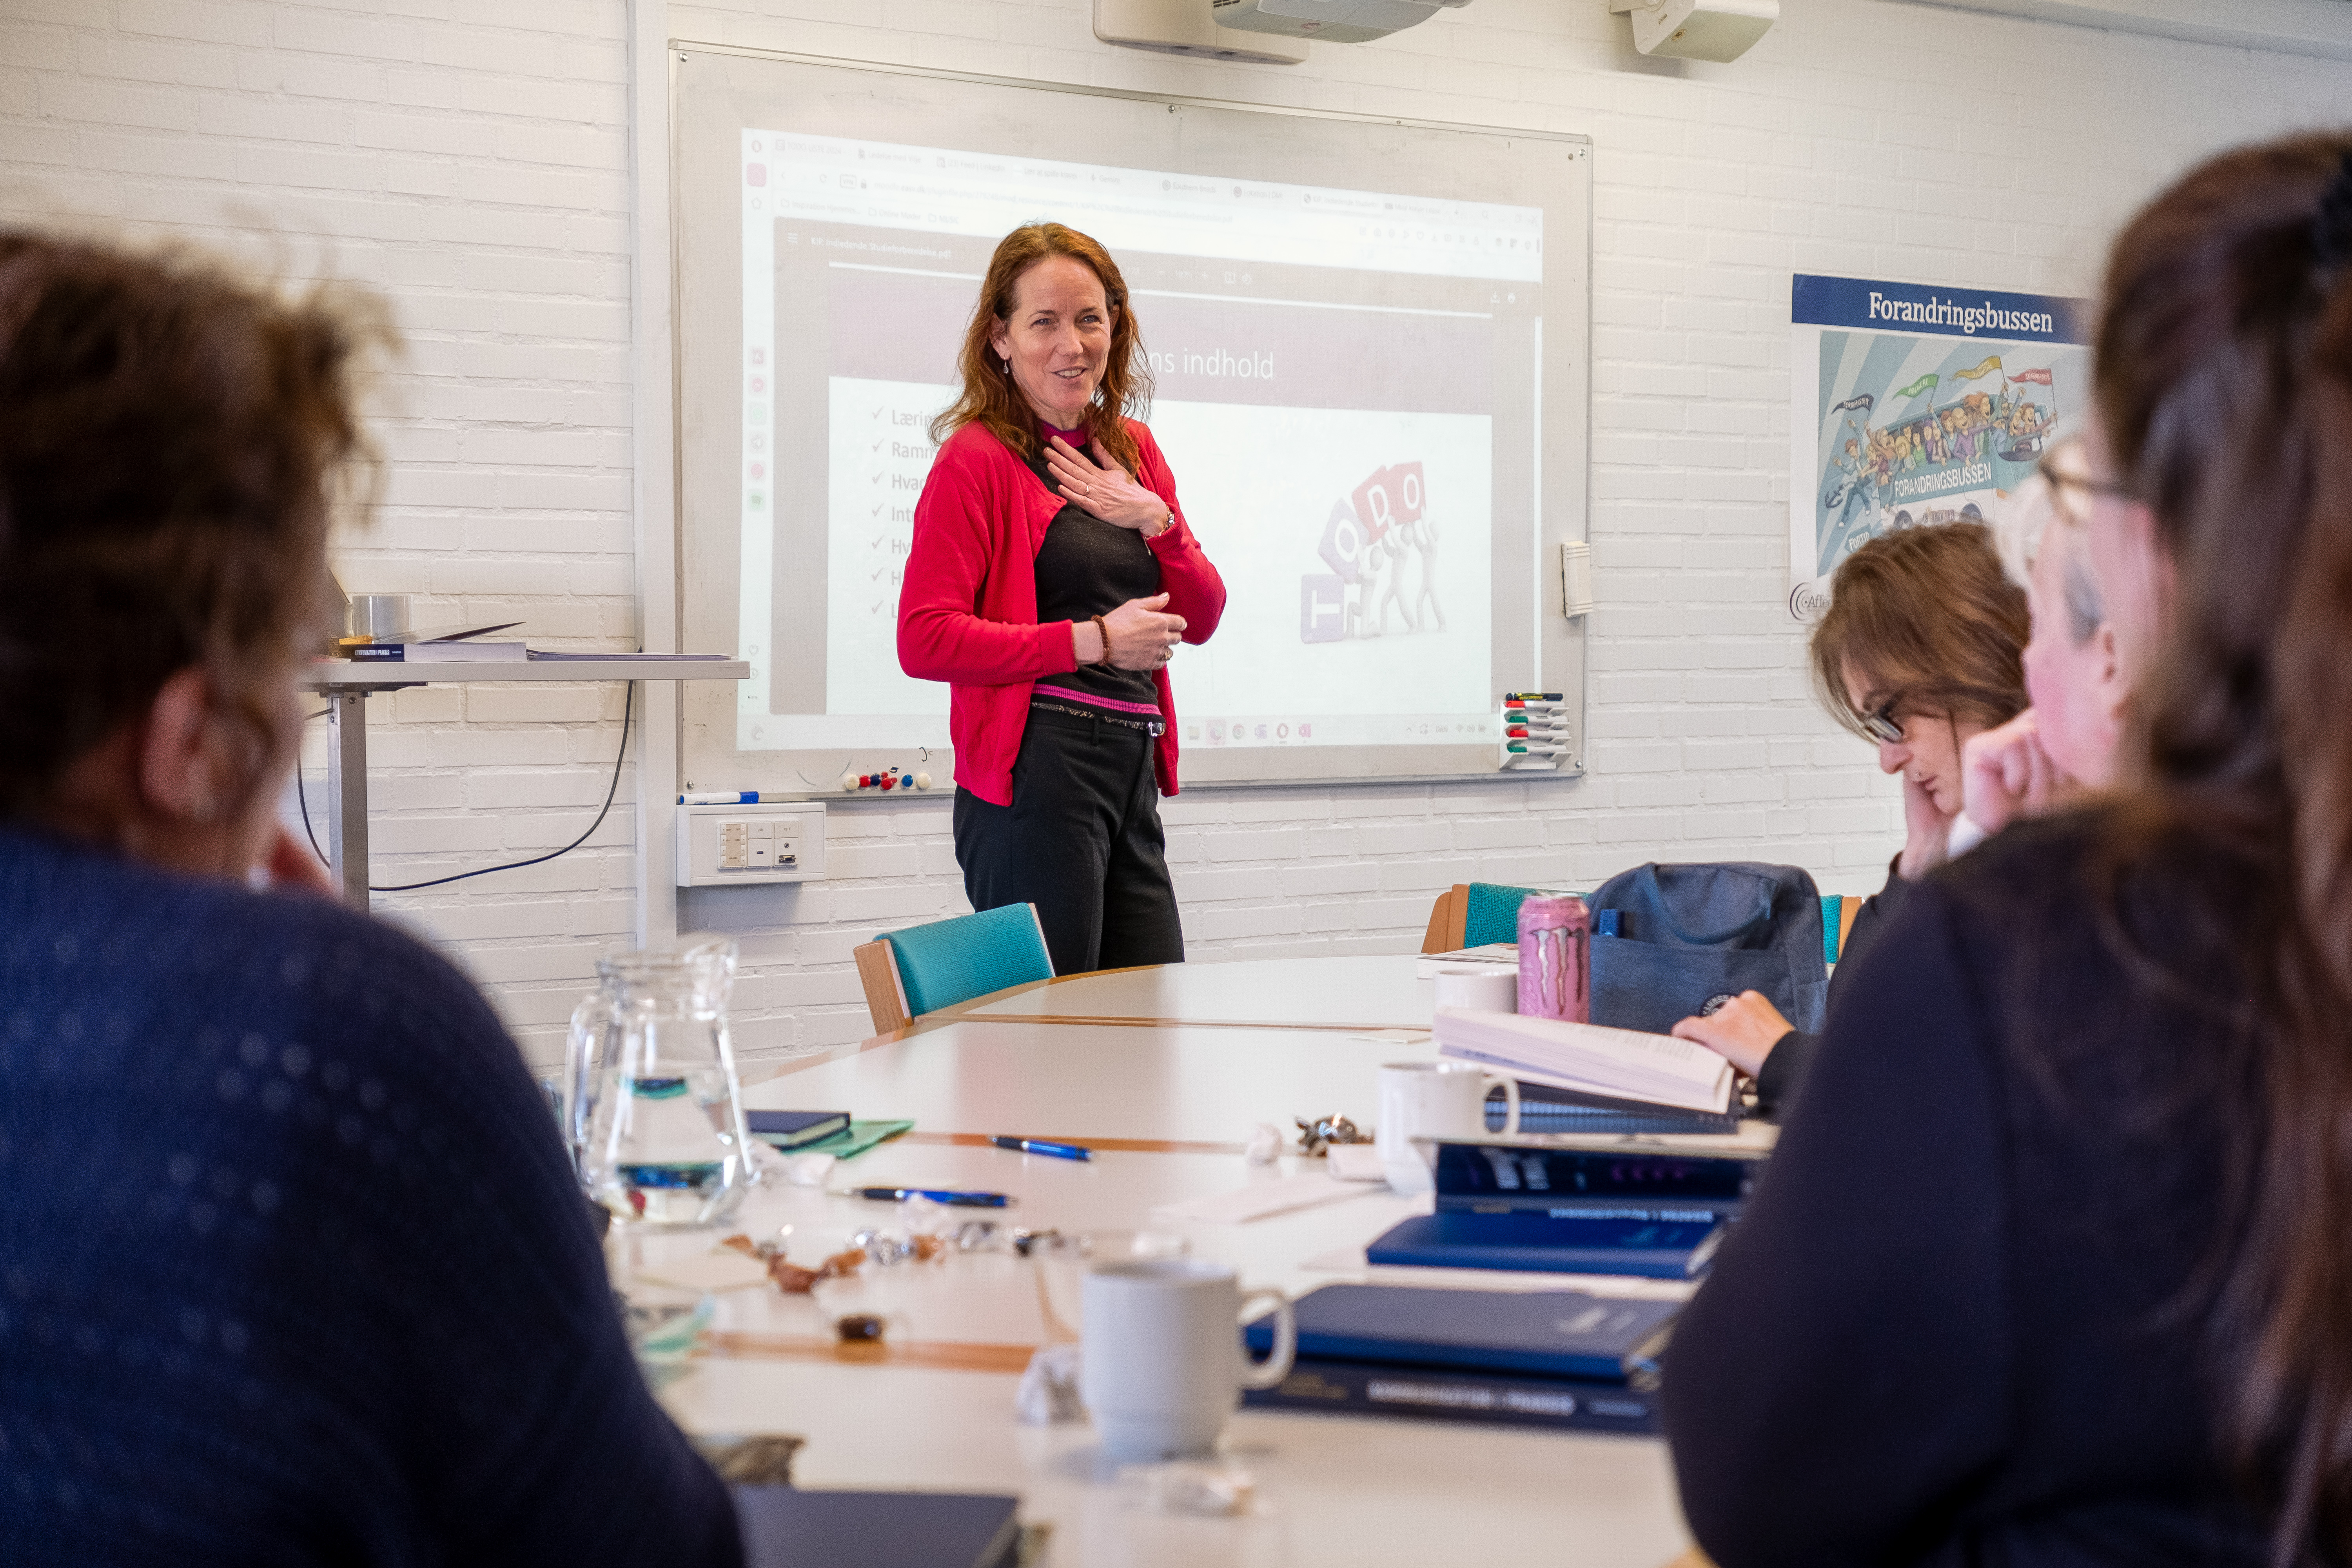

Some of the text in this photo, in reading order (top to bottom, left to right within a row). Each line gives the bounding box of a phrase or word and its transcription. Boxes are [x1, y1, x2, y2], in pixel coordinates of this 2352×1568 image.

[939, 214, 960, 224] MUSIC
[826, 238, 867, 250] Indledende
[1869, 292, 2053, 334] Forandringsbussen
[1149, 346, 1274, 380] ns indhold
[892, 409, 932, 426] Lærin
[1895, 461, 1992, 497] FORANDRINGSBUSSEN
